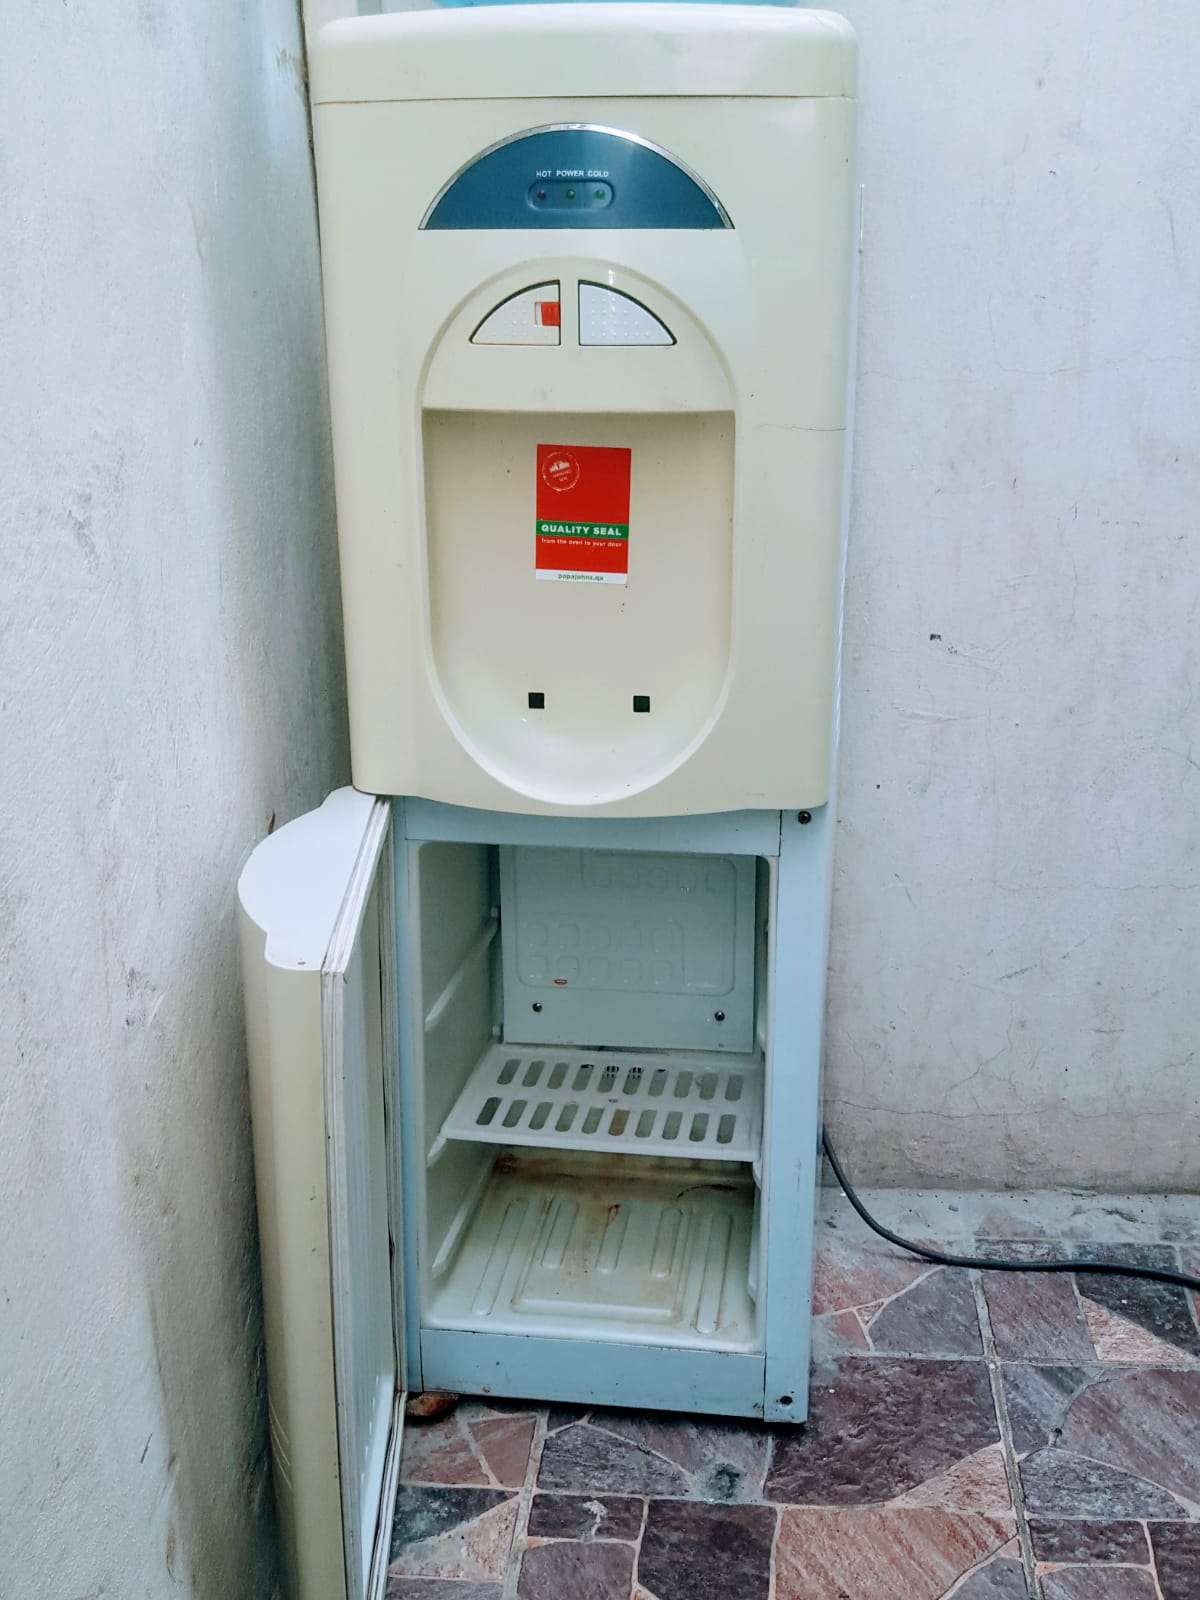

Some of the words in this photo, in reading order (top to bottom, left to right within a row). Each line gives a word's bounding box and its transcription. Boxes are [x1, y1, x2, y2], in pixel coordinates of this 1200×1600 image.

[535, 170, 552, 178] HOT
[587, 170, 609, 178] COLD
[541, 524, 590, 534] QUALITY
[593, 527, 622, 536] SEAL
[541, 537, 556, 545] from
